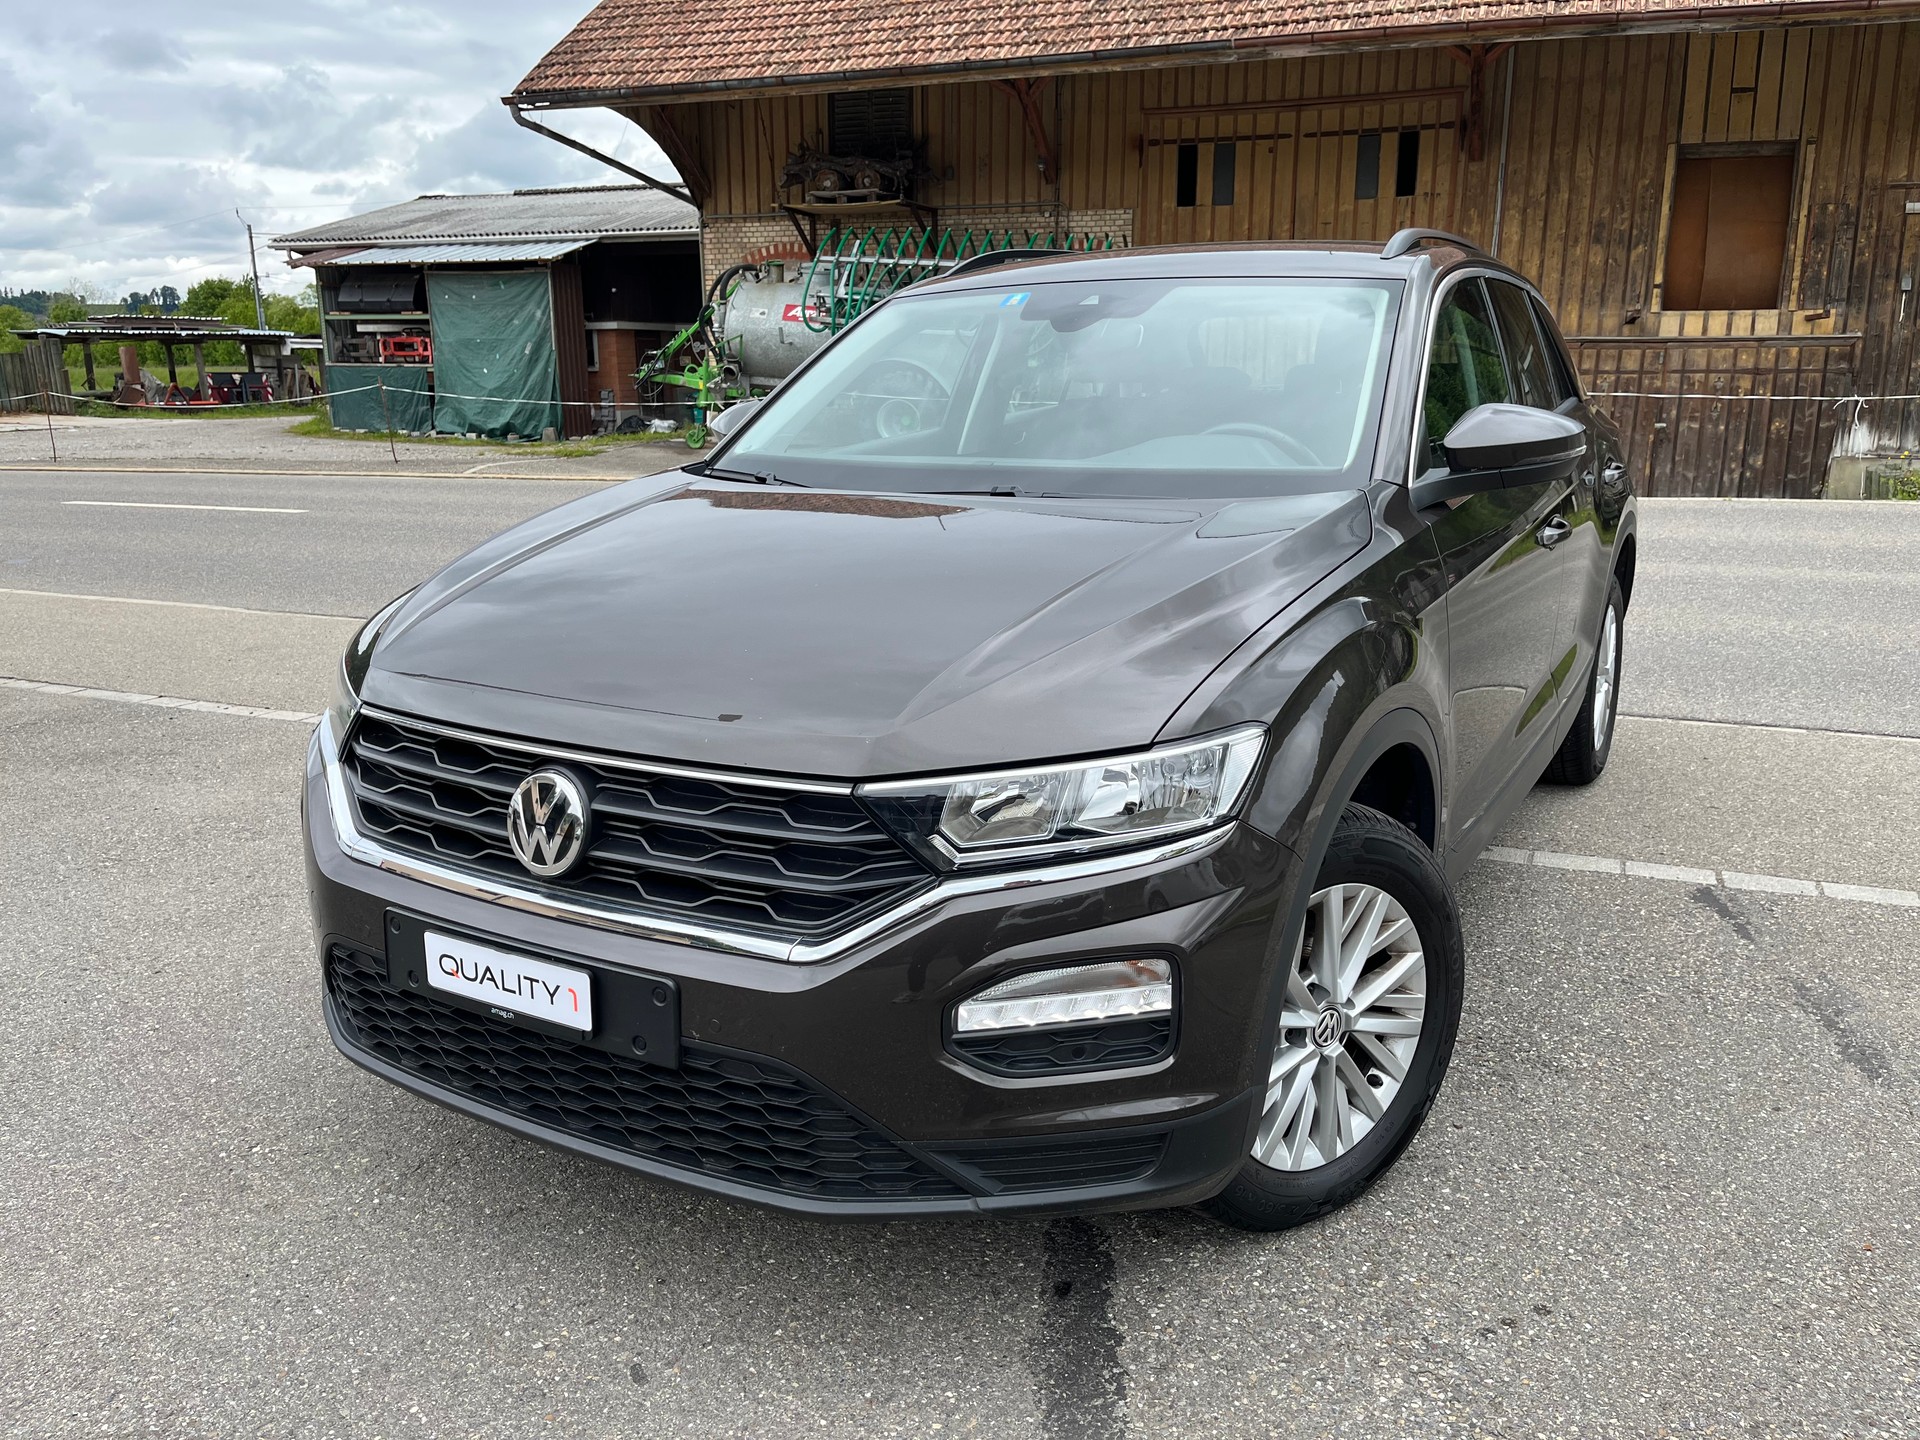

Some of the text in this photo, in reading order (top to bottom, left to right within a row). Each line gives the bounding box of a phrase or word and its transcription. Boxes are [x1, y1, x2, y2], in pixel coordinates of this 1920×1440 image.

[510, 771, 583, 871] VW
[438, 953, 579, 1012] QUALITY 1
